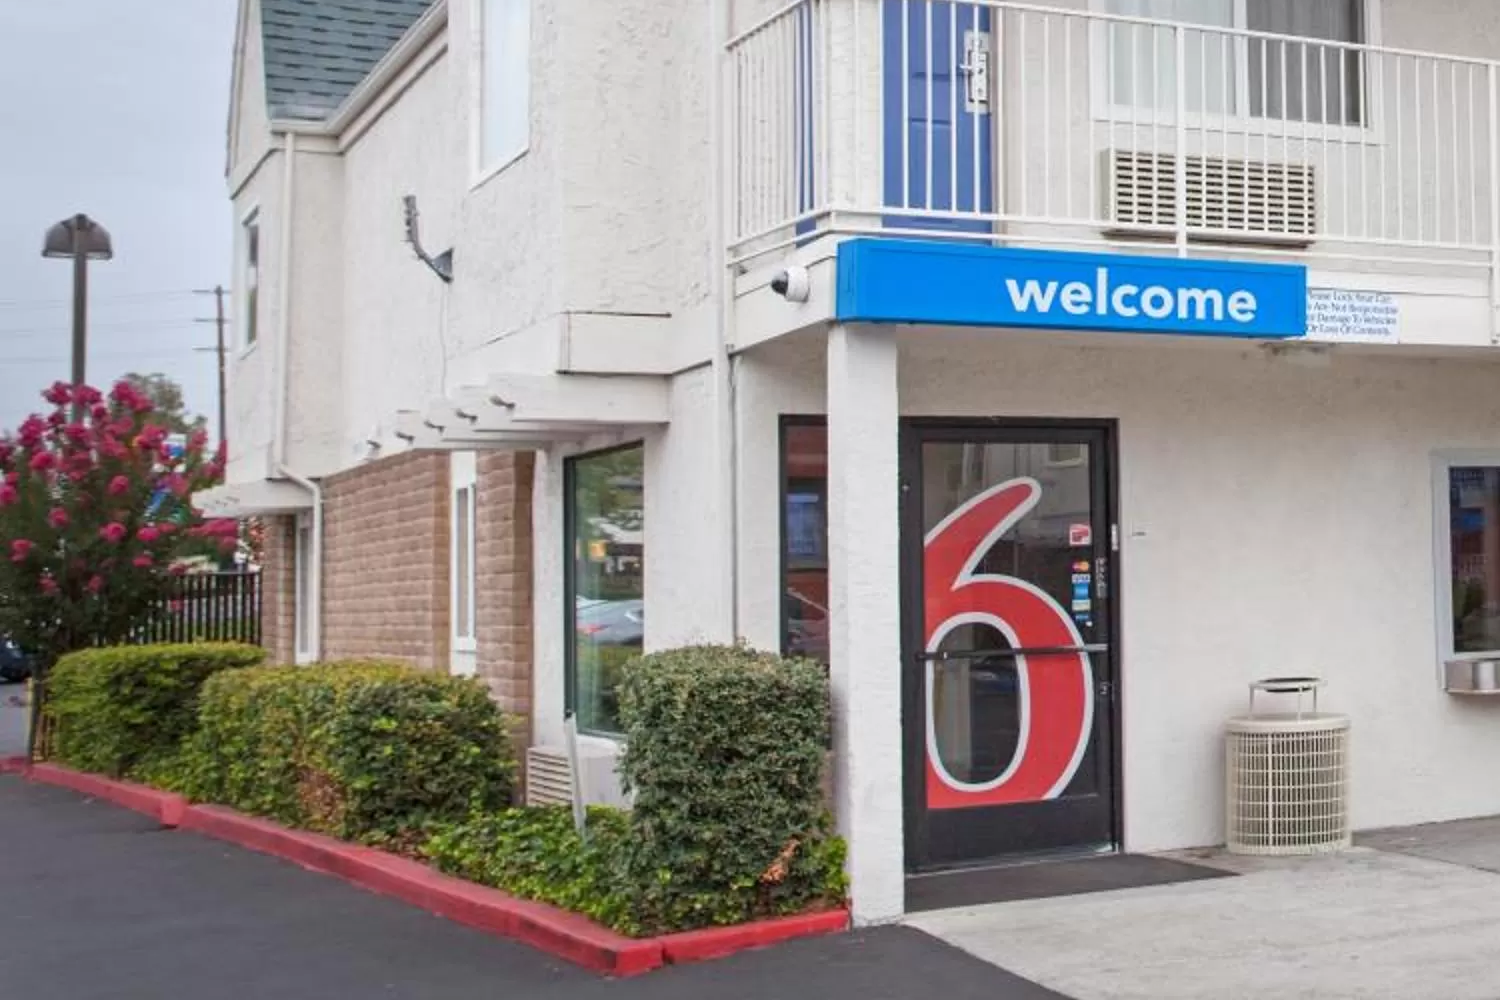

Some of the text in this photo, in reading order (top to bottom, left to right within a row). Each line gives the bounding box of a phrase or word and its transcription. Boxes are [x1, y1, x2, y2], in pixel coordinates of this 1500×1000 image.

[1005, 267, 1257, 322] welcome
[1331, 302, 1347, 312] Not
[924, 476, 1094, 808] 6
